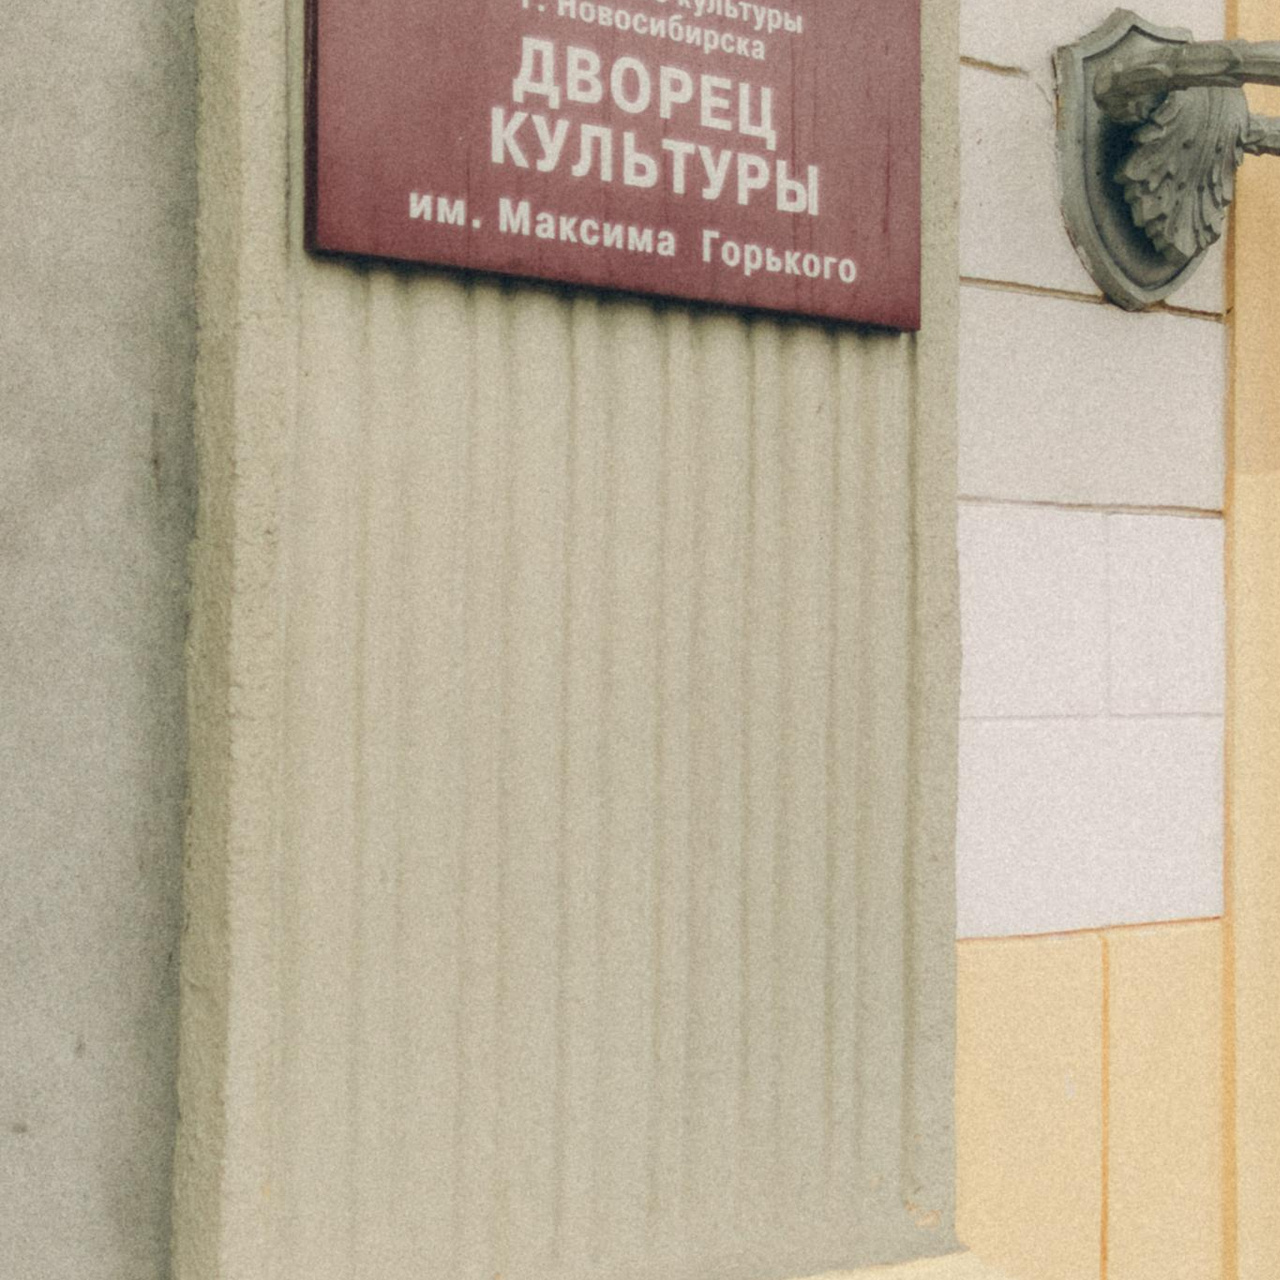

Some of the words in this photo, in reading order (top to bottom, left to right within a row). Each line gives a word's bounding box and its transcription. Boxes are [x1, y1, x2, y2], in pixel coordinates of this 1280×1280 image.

[511, 35, 778, 152] ДВОРЕЦ
[490, 104, 821, 217] КУЛЬТУРЫ
[408, 190, 482, 230] им.
[497, 196, 677, 257] Максима
[701, 228, 858, 284] Горького
